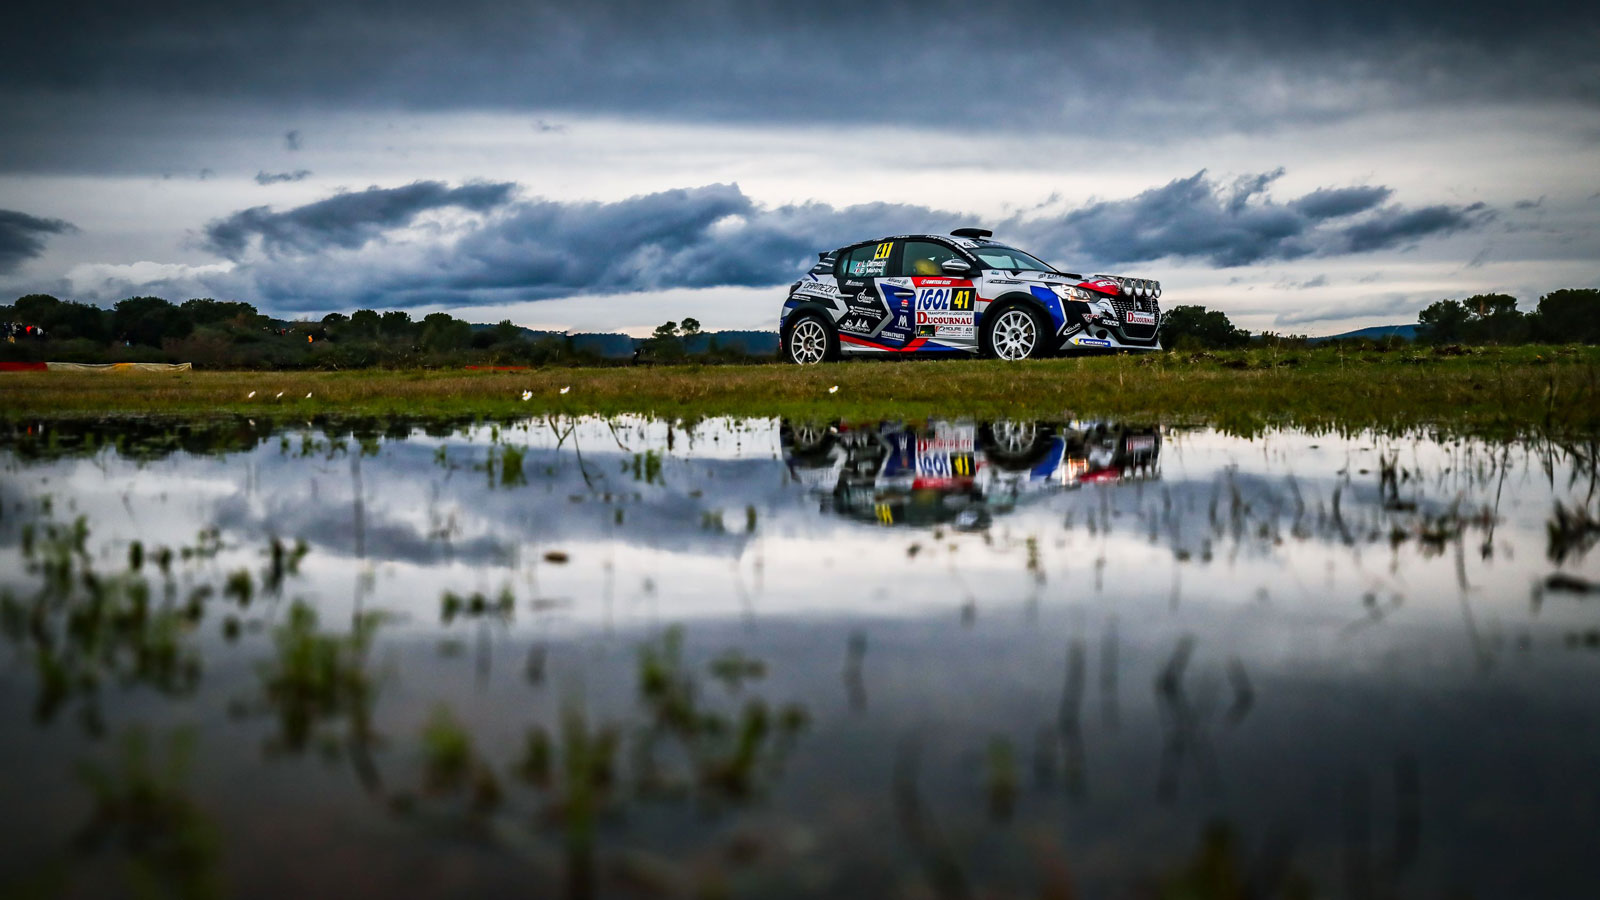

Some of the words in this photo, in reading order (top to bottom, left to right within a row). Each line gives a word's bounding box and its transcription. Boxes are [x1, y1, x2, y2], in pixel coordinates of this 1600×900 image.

[876, 243, 890, 258] 41
[918, 289, 950, 310] IGOL
[954, 290, 970, 309] 41
[916, 311, 972, 324] DUCOURNAU
